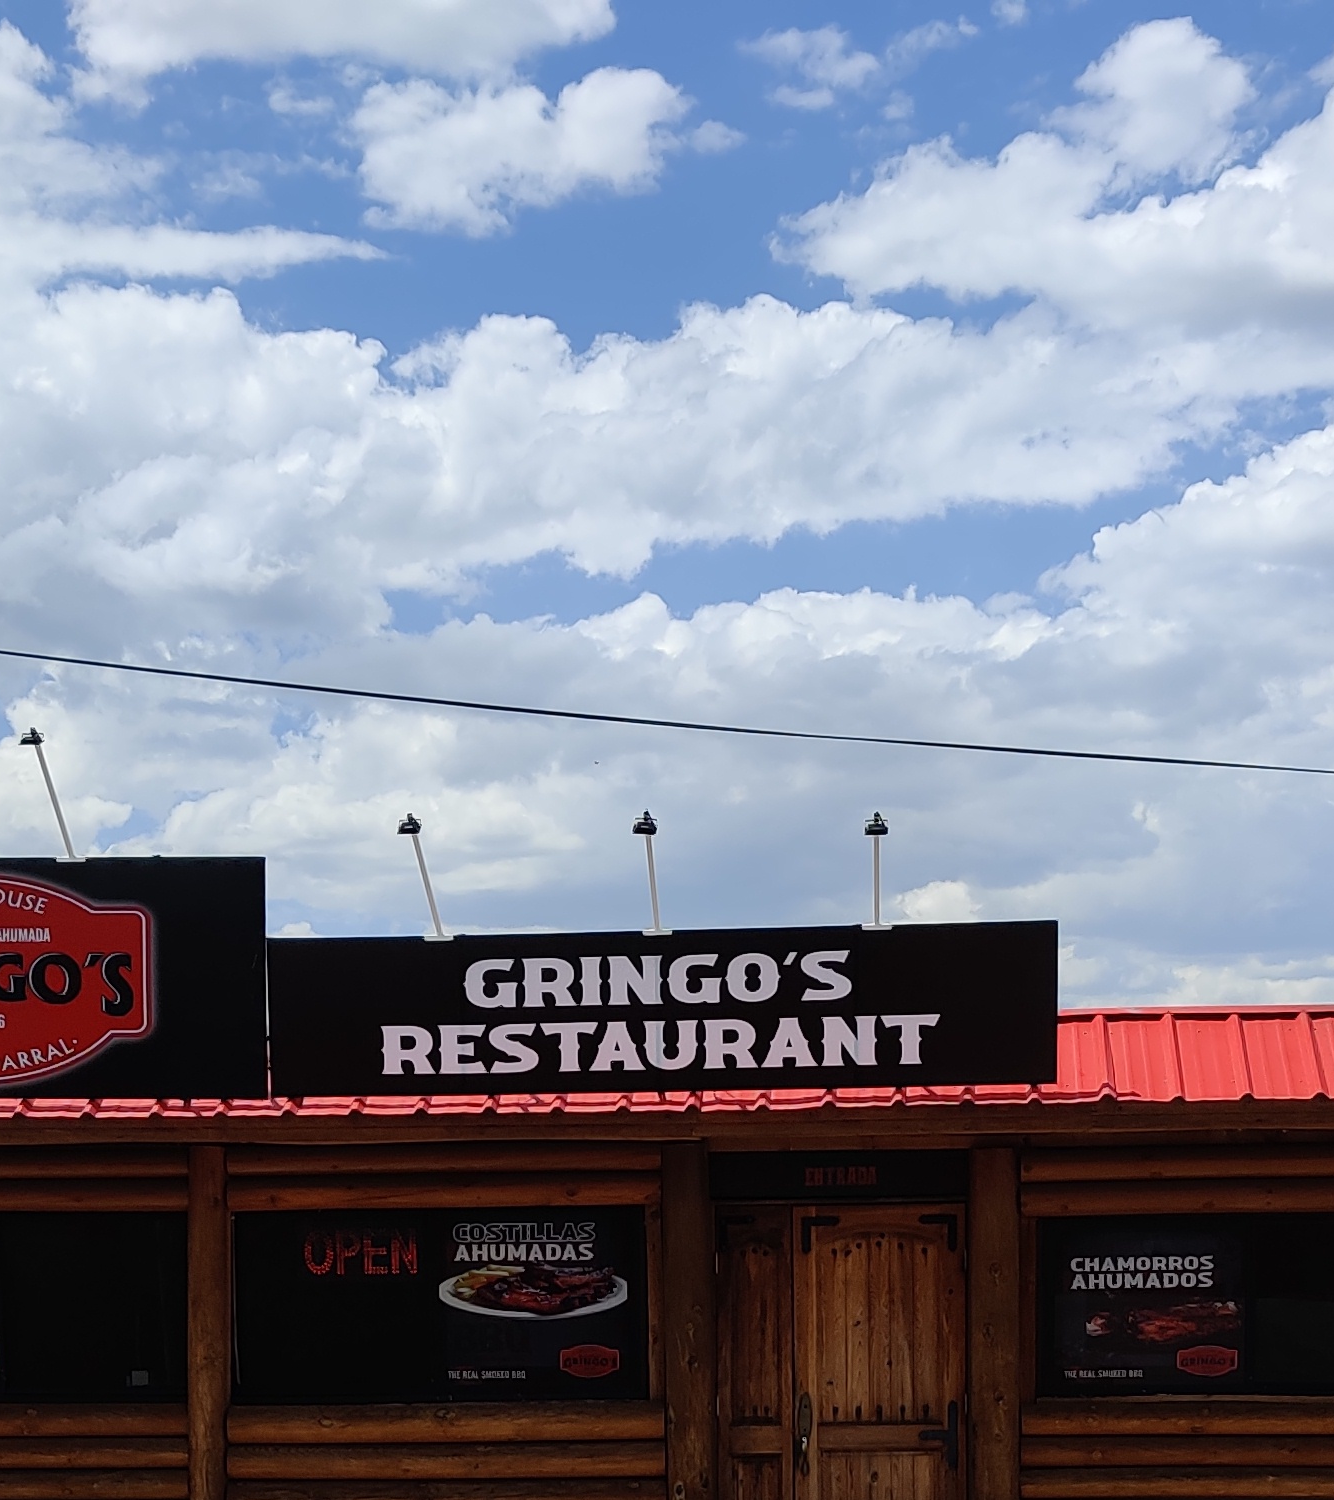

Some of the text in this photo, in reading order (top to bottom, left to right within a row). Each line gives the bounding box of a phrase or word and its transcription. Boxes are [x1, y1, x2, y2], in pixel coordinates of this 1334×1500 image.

[463, 950, 853, 1008] GRINGO'S
[380, 1014, 941, 1075] RESTAURANT
[452, 1222, 598, 1243] COSTILLAS
[302, 1229, 419, 1276] OPEN
[453, 1243, 596, 1262] AHUMADAS
[1070, 1255, 1214, 1272] CHAMORROS
[1070, 1272, 1214, 1290] AHUMADOS
[1180, 1356, 1235, 1367] GRINGOS
